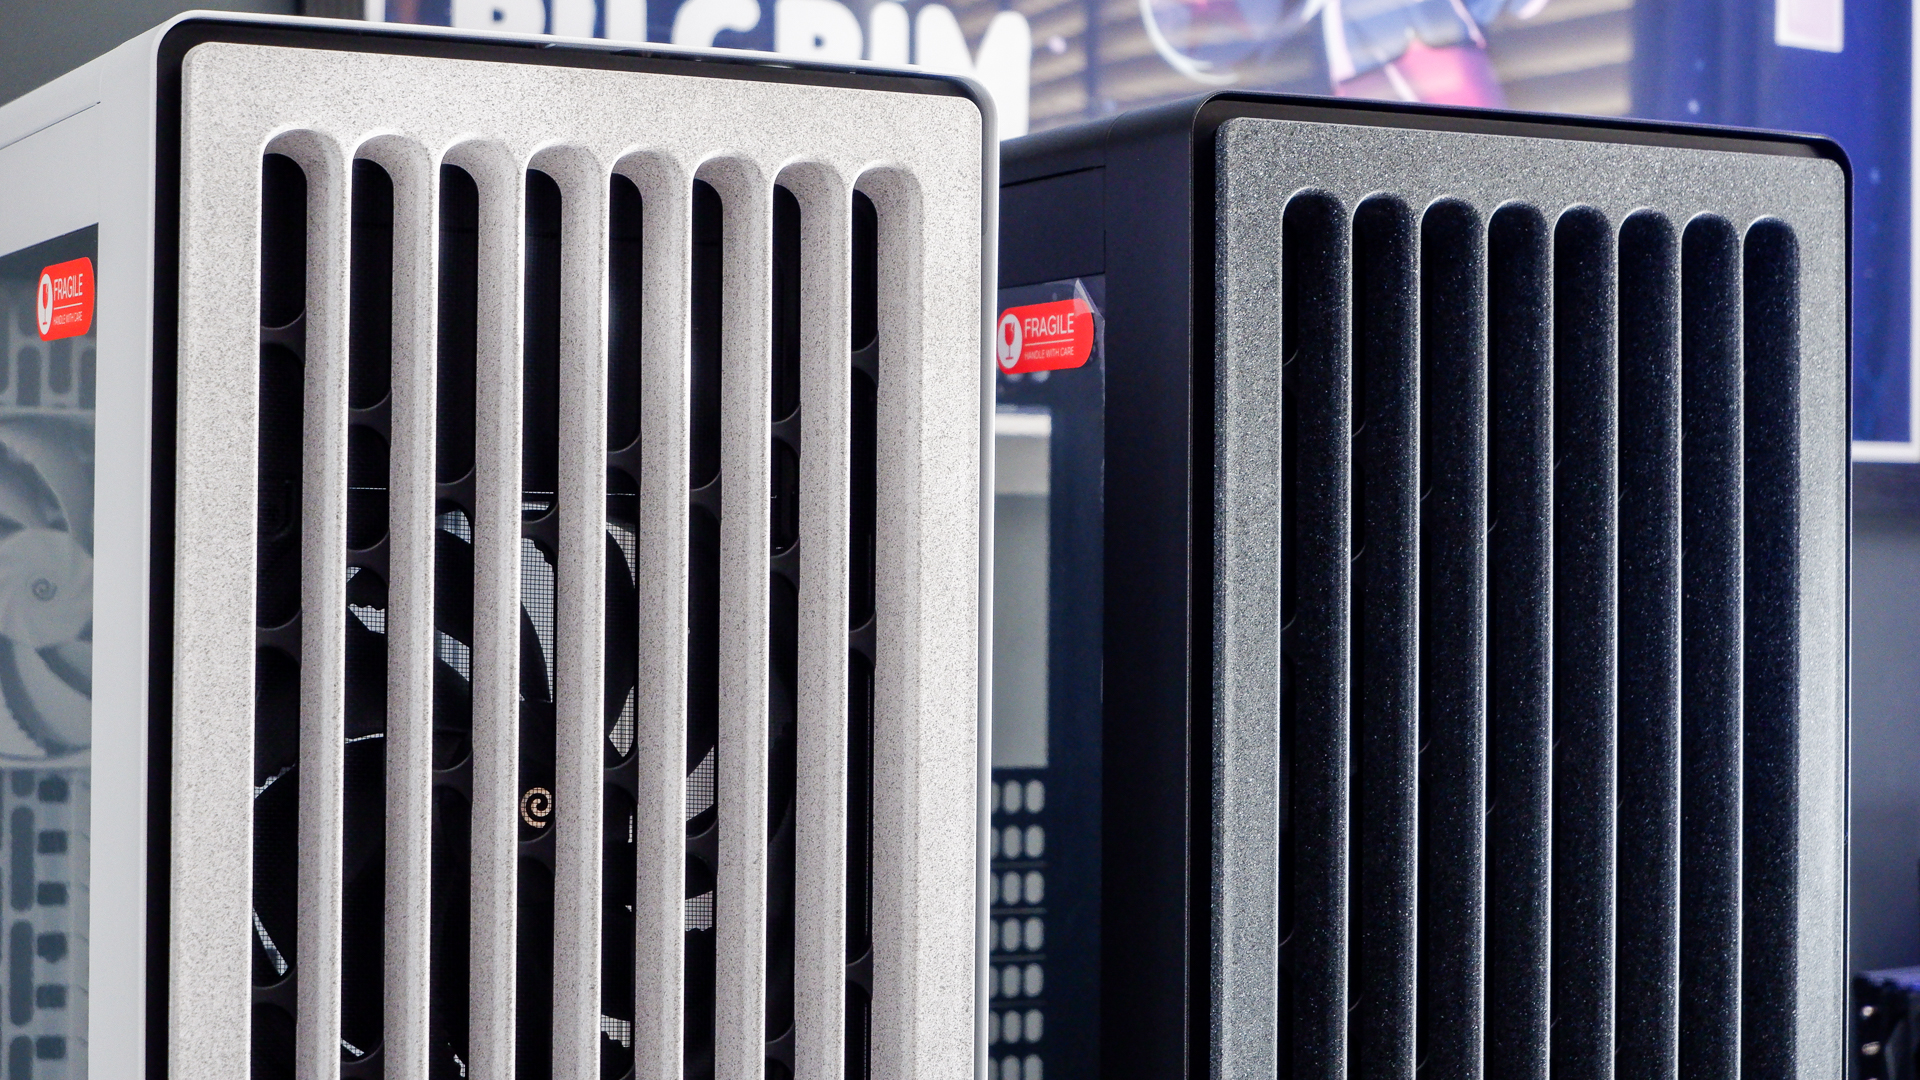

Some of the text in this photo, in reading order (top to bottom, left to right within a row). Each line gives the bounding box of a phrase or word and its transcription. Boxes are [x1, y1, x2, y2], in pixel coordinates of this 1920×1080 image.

[53, 273, 83, 300] FRAGILE
[1025, 313, 1074, 338] FRAGILE
[1024, 346, 1074, 360] HANDLE WITH CARE
